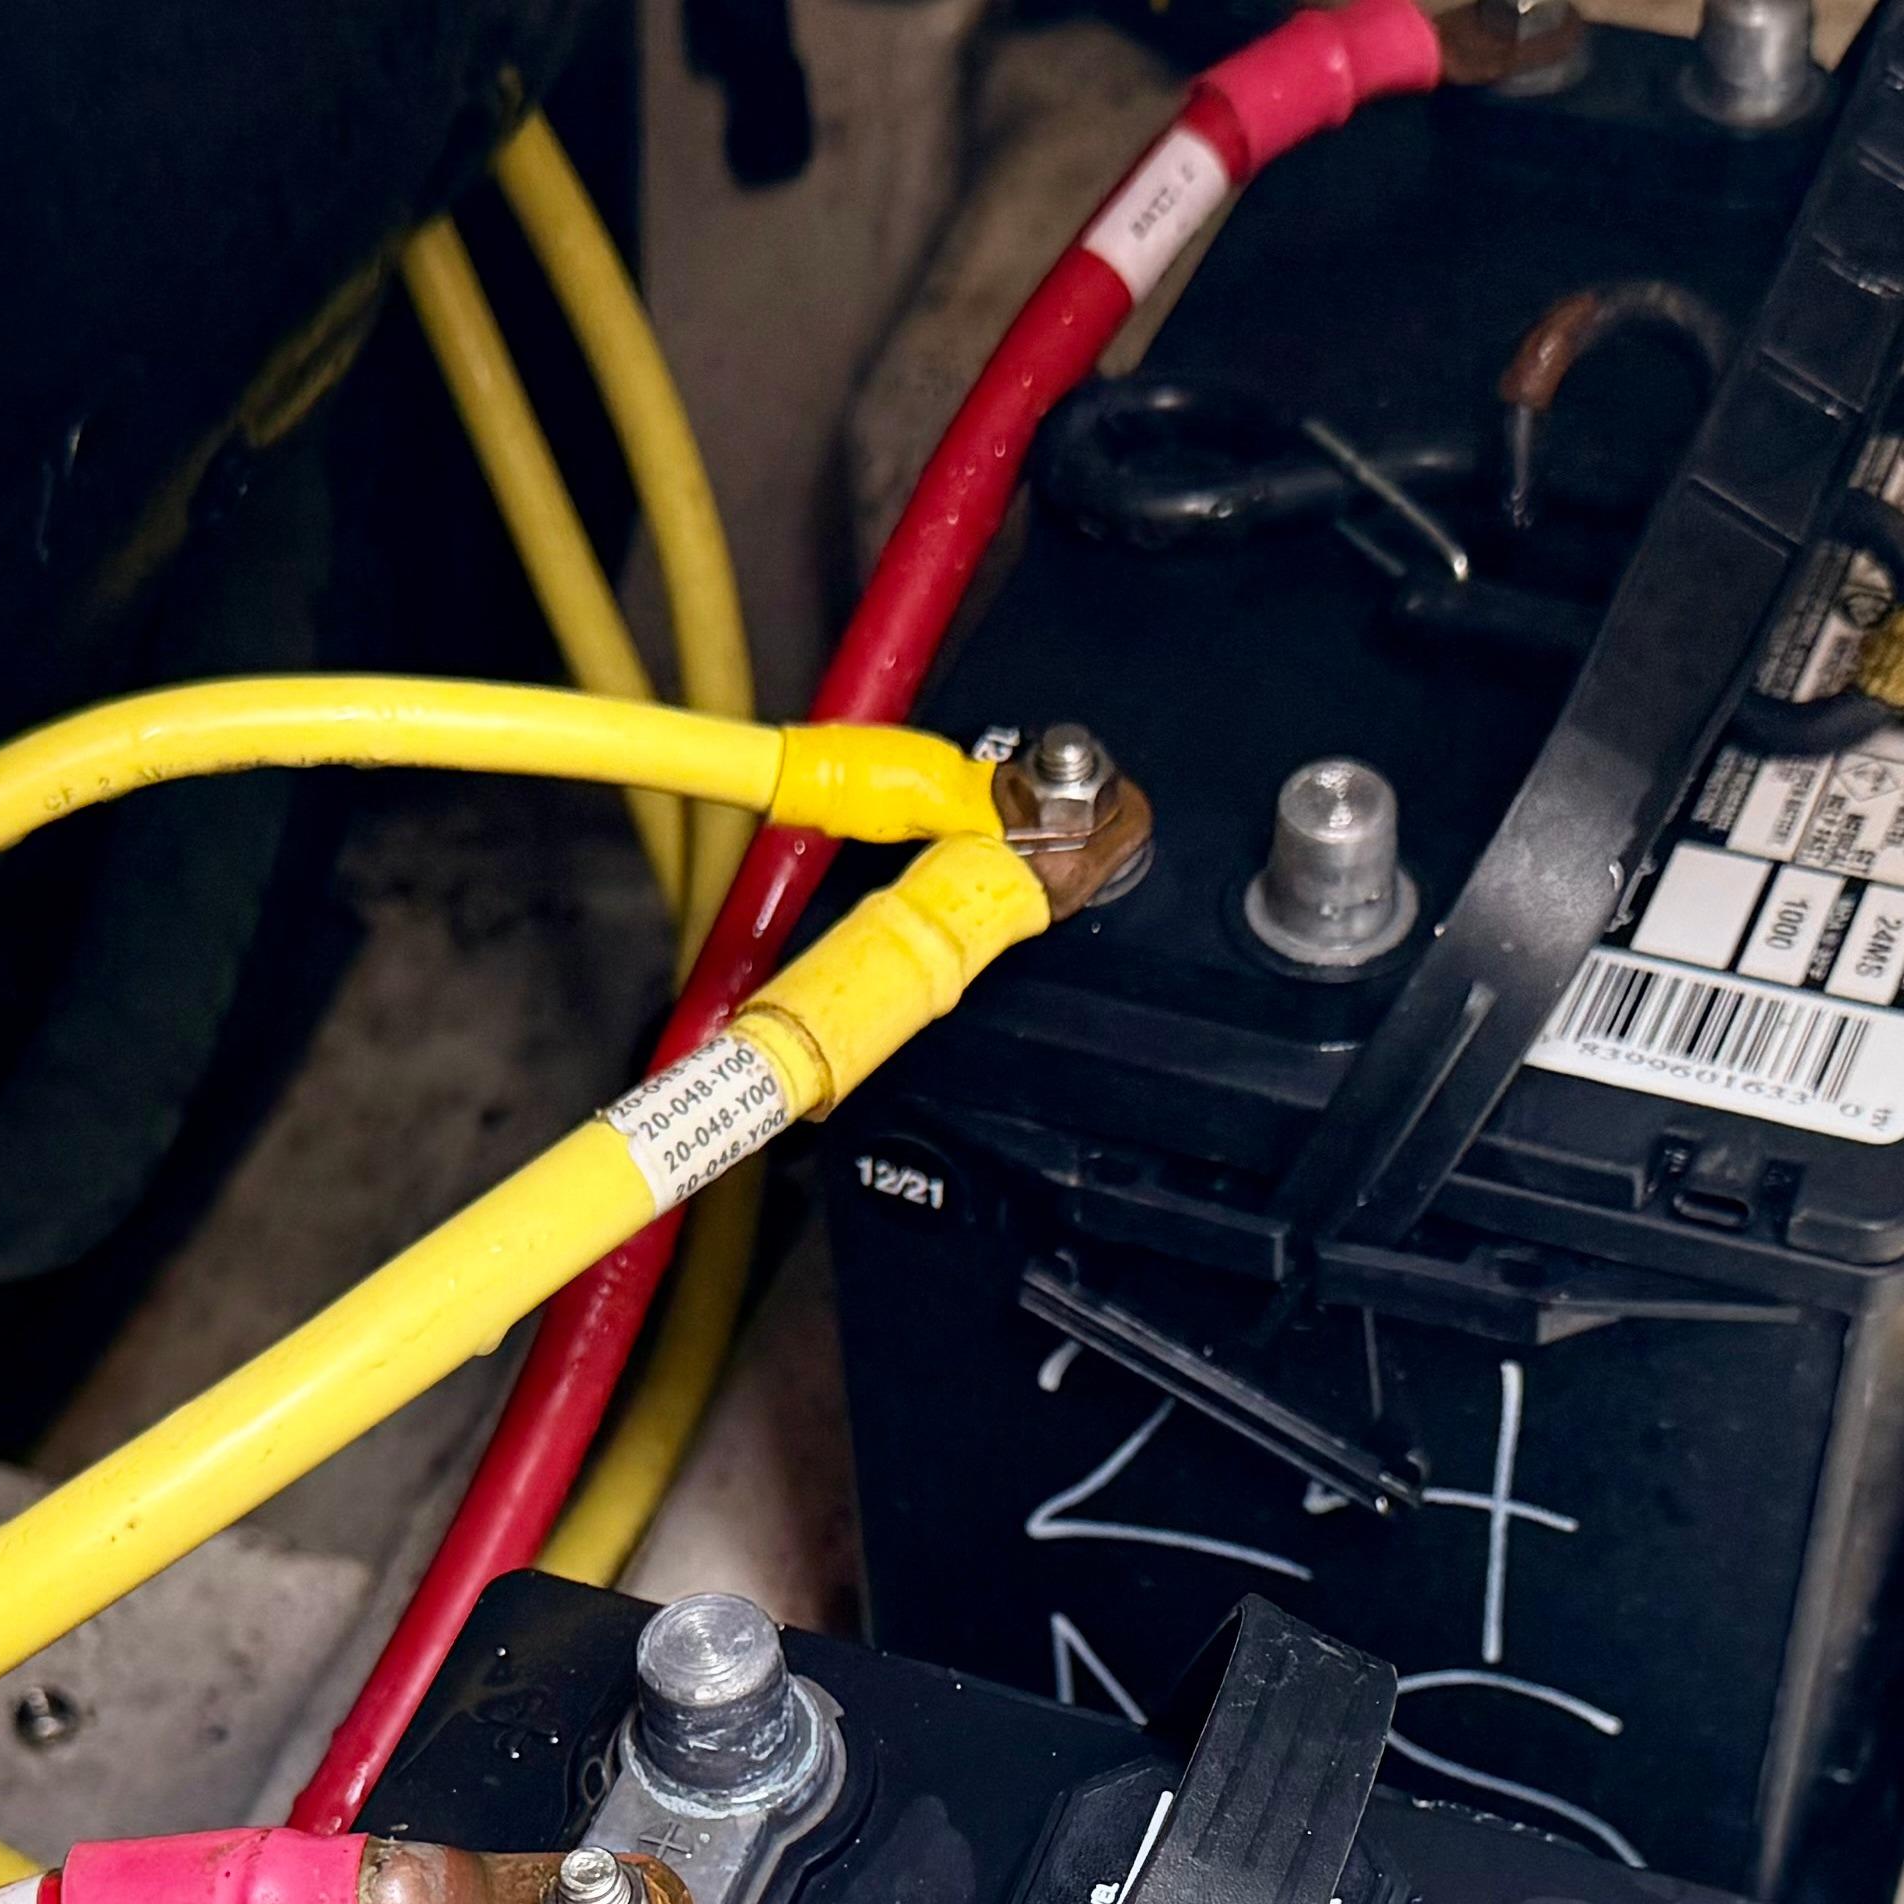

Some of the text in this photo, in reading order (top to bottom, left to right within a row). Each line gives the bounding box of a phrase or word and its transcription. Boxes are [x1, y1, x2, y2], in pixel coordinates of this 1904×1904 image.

[1764, 894, 1810, 951] 1000
[1852, 913, 1903, 980] 24MS
[638, 1044, 756, 1141] 20-048-Y00
[662, 1071, 779, 1174] 20-048-Y00
[675, 1106, 787, 1200] 20-048-Y00
[857, 1152, 944, 1209] 12/21
